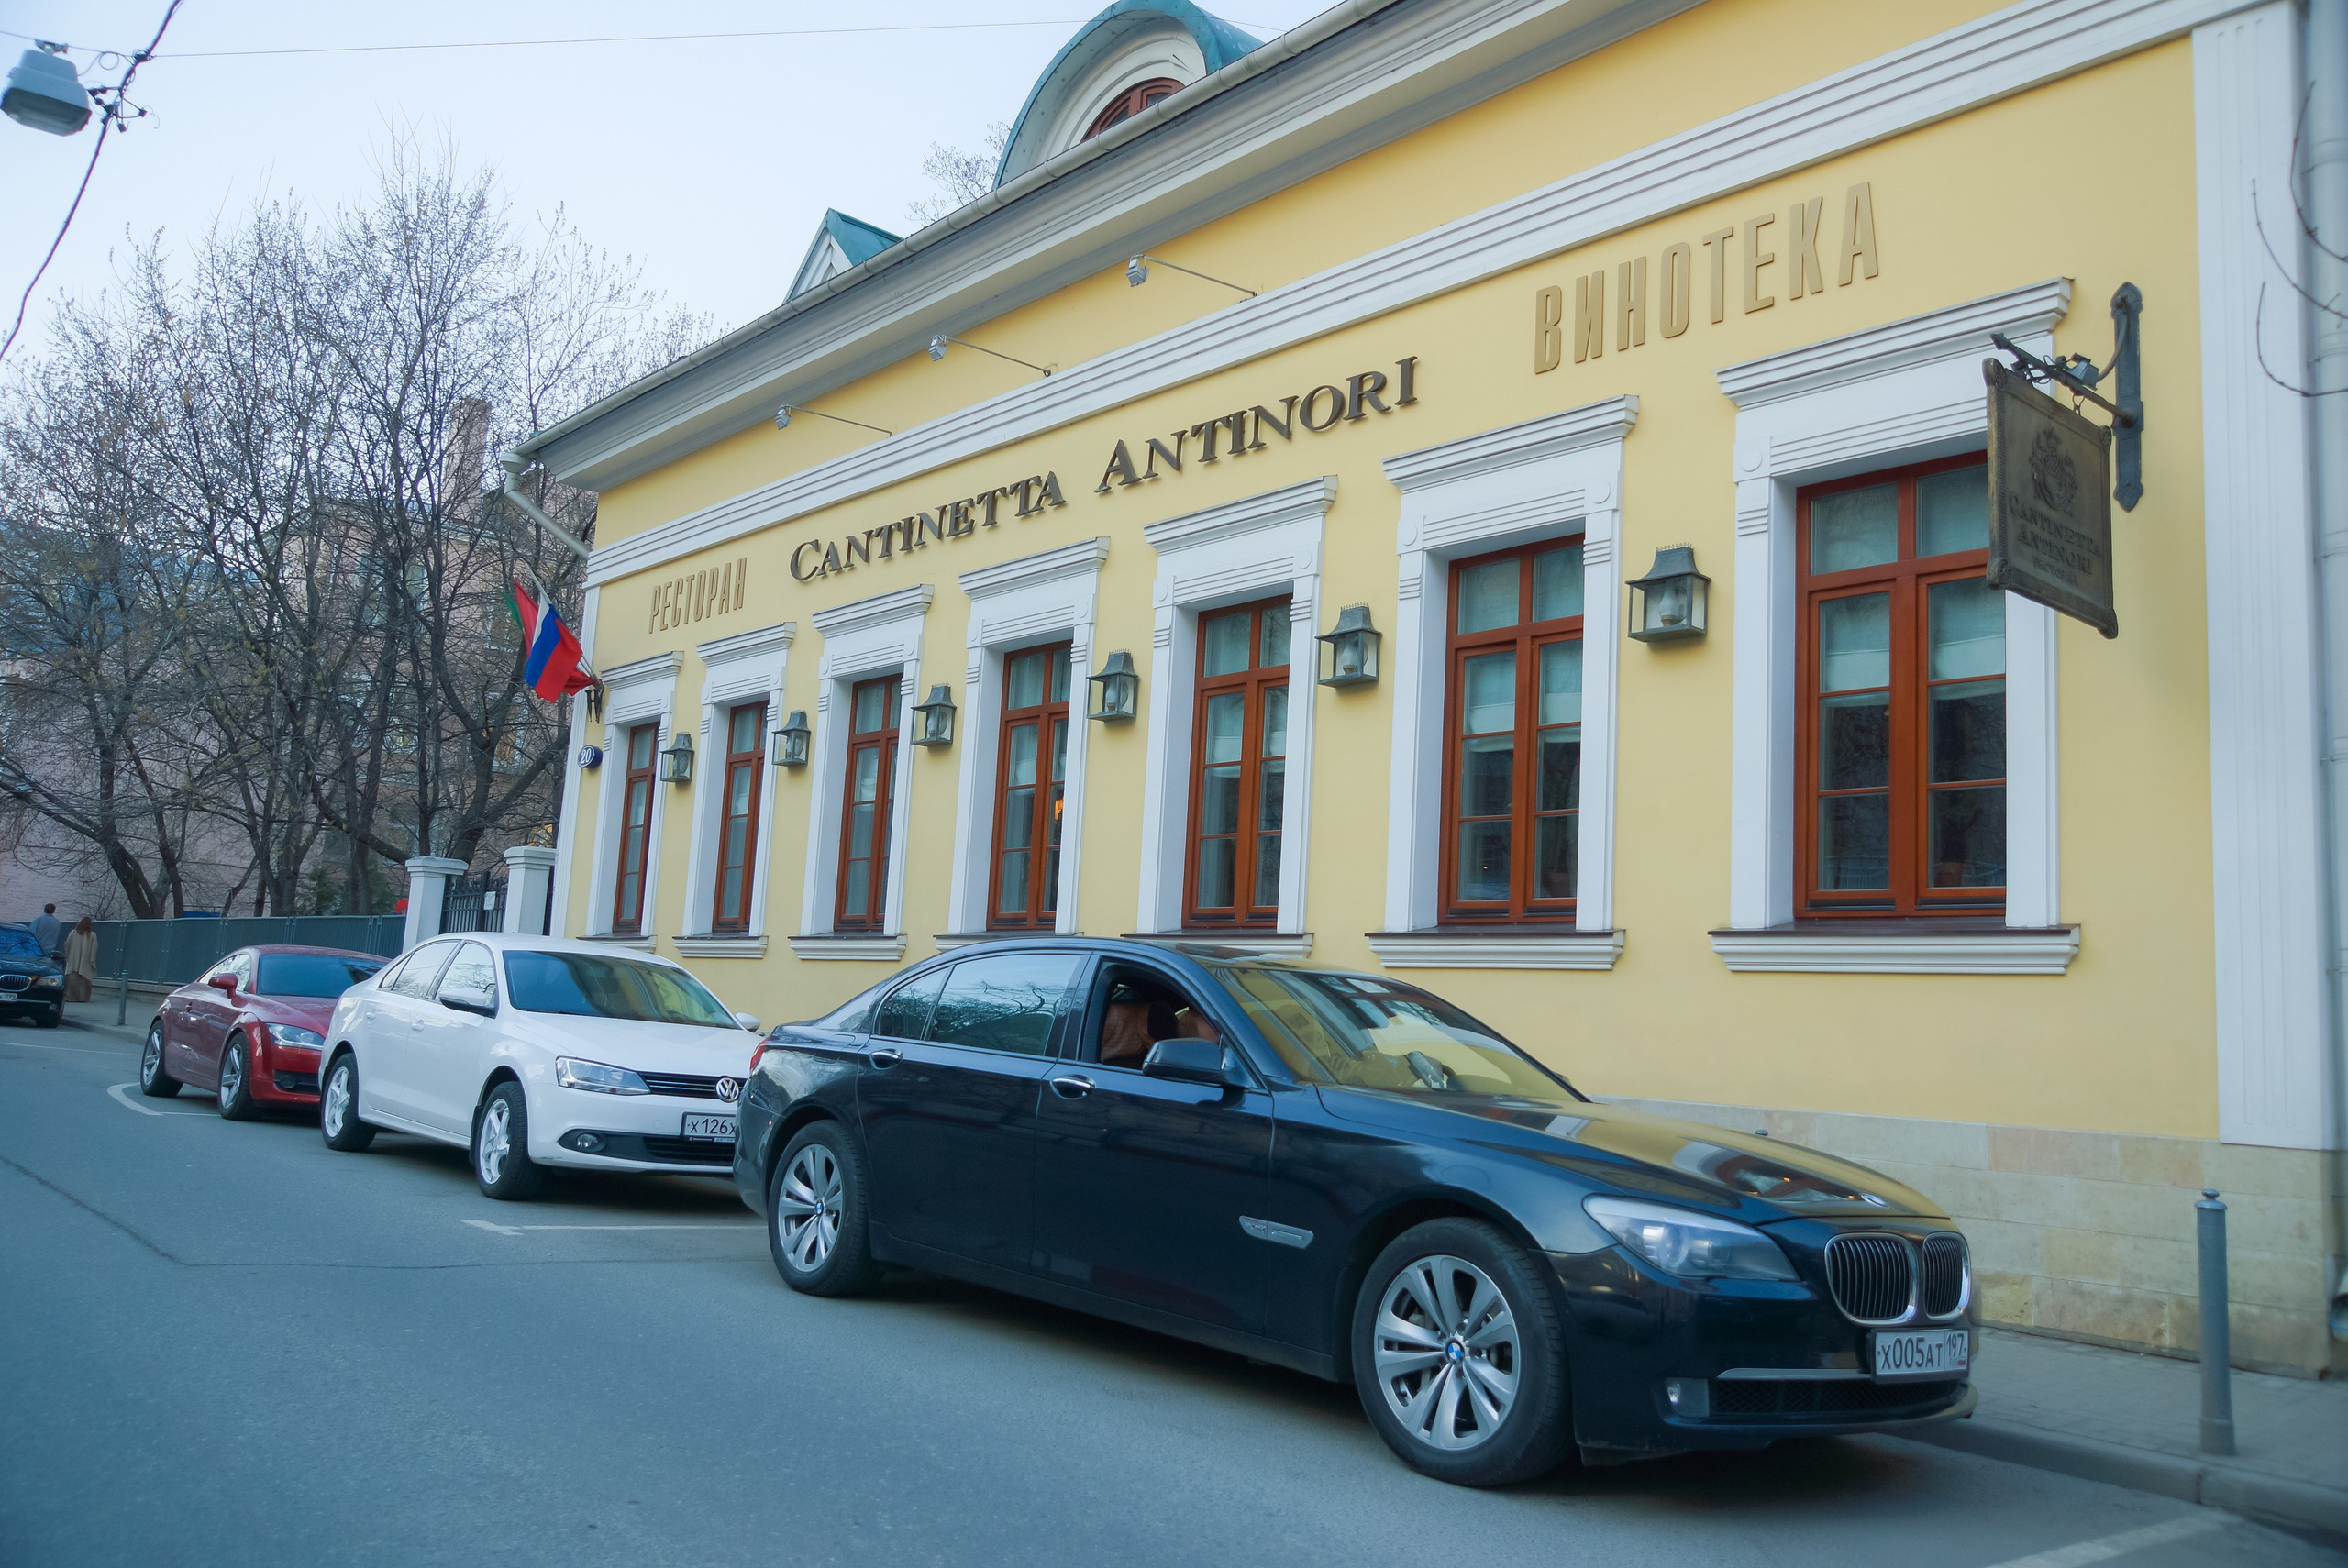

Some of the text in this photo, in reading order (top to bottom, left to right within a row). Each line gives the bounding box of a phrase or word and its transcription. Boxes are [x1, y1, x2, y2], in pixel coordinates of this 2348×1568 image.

[1534, 181, 1878, 375] ВИНОТЕКА
[790, 356, 1419, 582] CANTINETTA ANTINORI
[2009, 492, 2101, 557] CANTINETTA
[2017, 523, 2092, 575] ANTINORI
[648, 557, 748, 634] РЕСТОРАН
[580, 747, 592, 764] 20
[1945, 1333, 1965, 1356] 197
